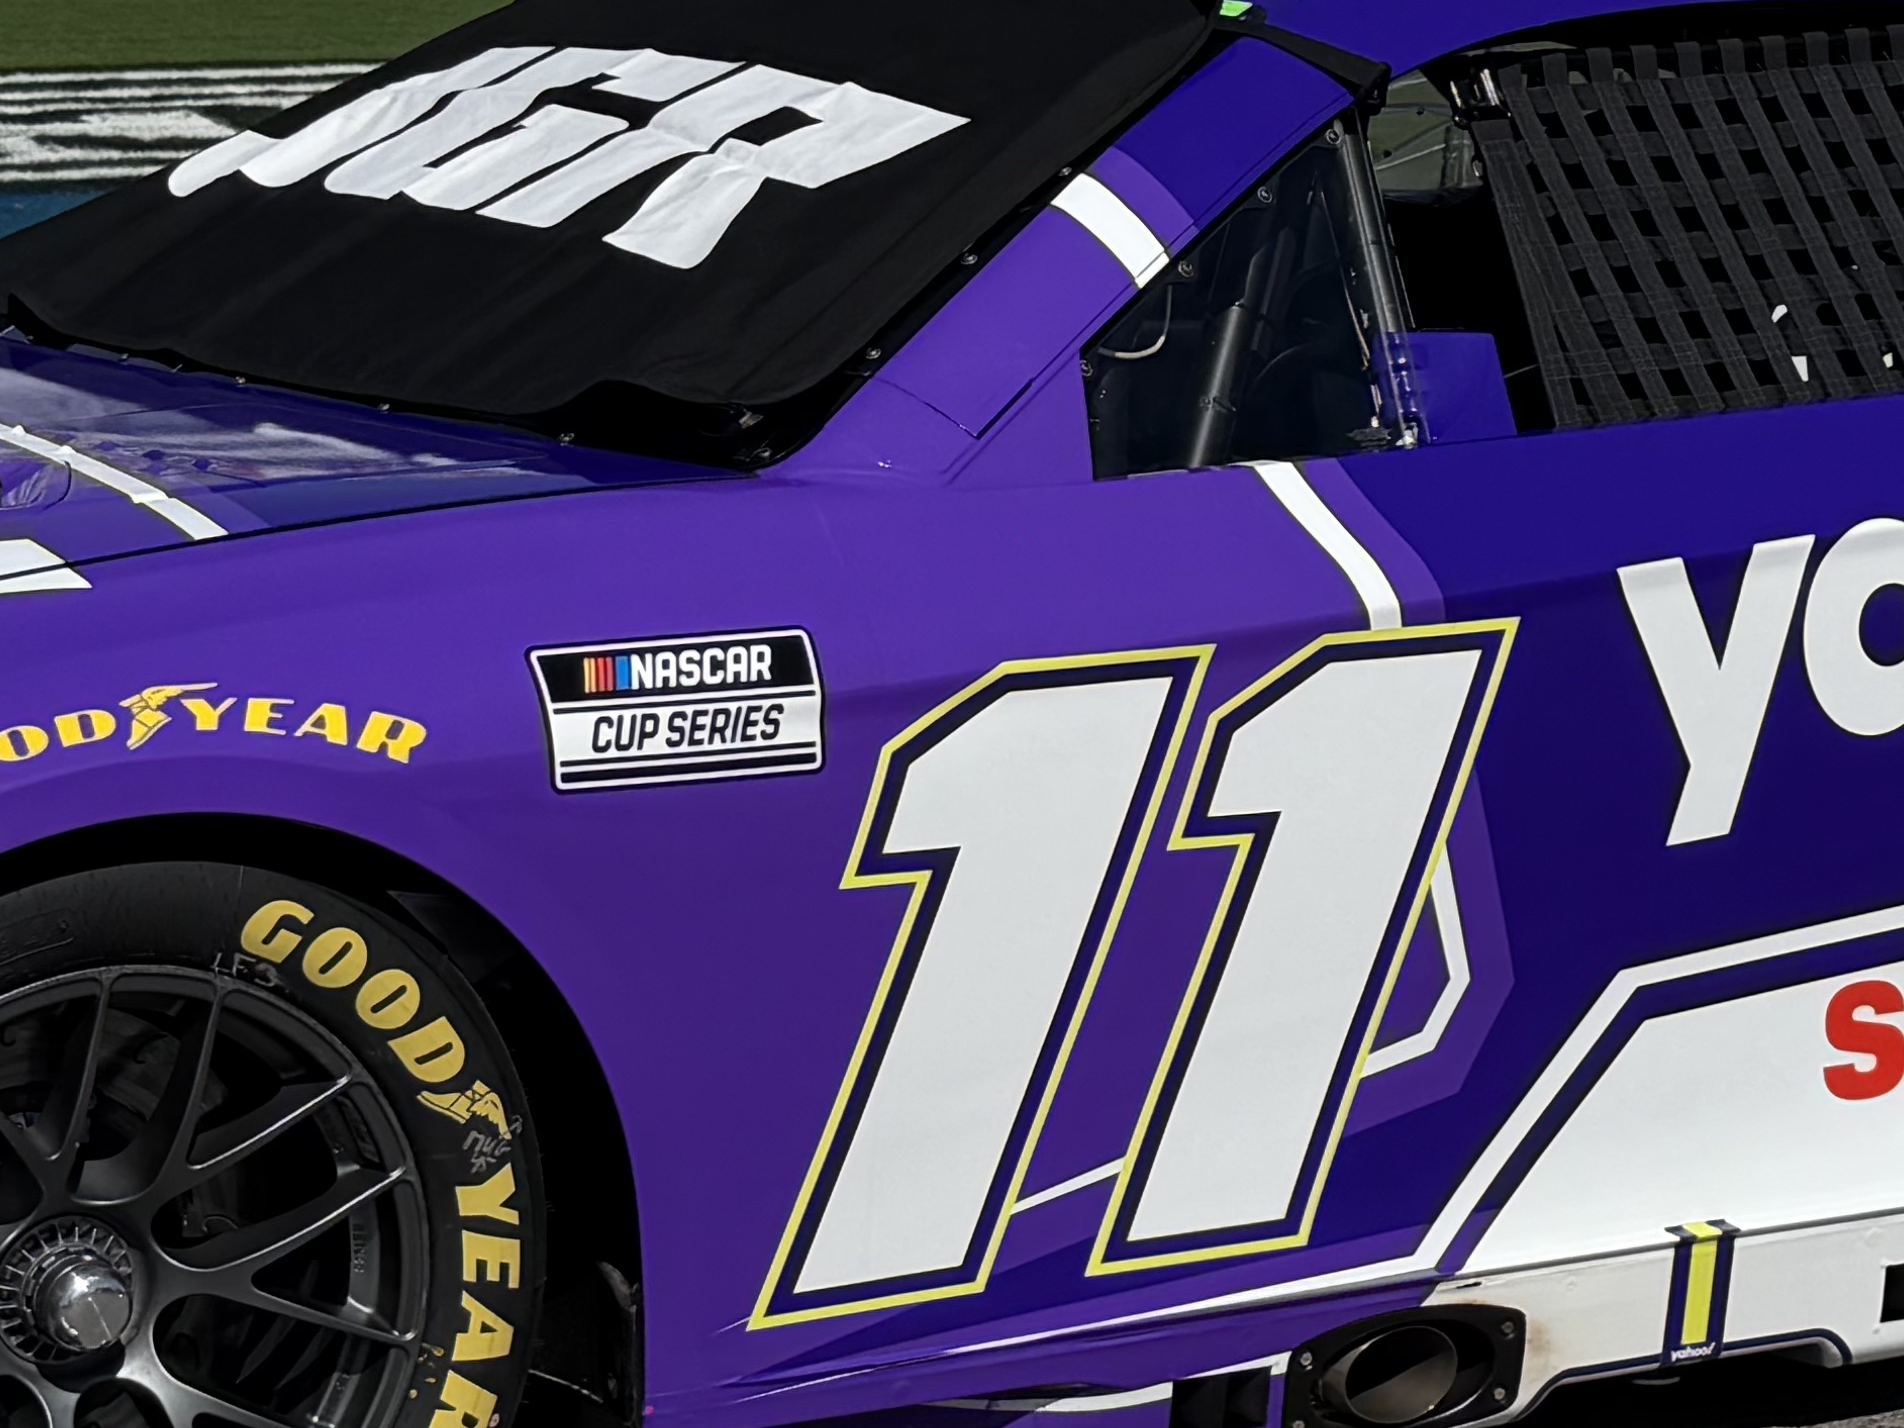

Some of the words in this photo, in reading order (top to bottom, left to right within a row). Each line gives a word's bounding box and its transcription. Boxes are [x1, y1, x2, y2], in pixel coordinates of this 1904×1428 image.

[167, 44, 972, 270] JGR
[590, 710, 660, 755] CUP
[664, 702, 785, 749] SERIES
[628, 643, 773, 692] NASCAR
[745, 616, 1521, 1331] 11
